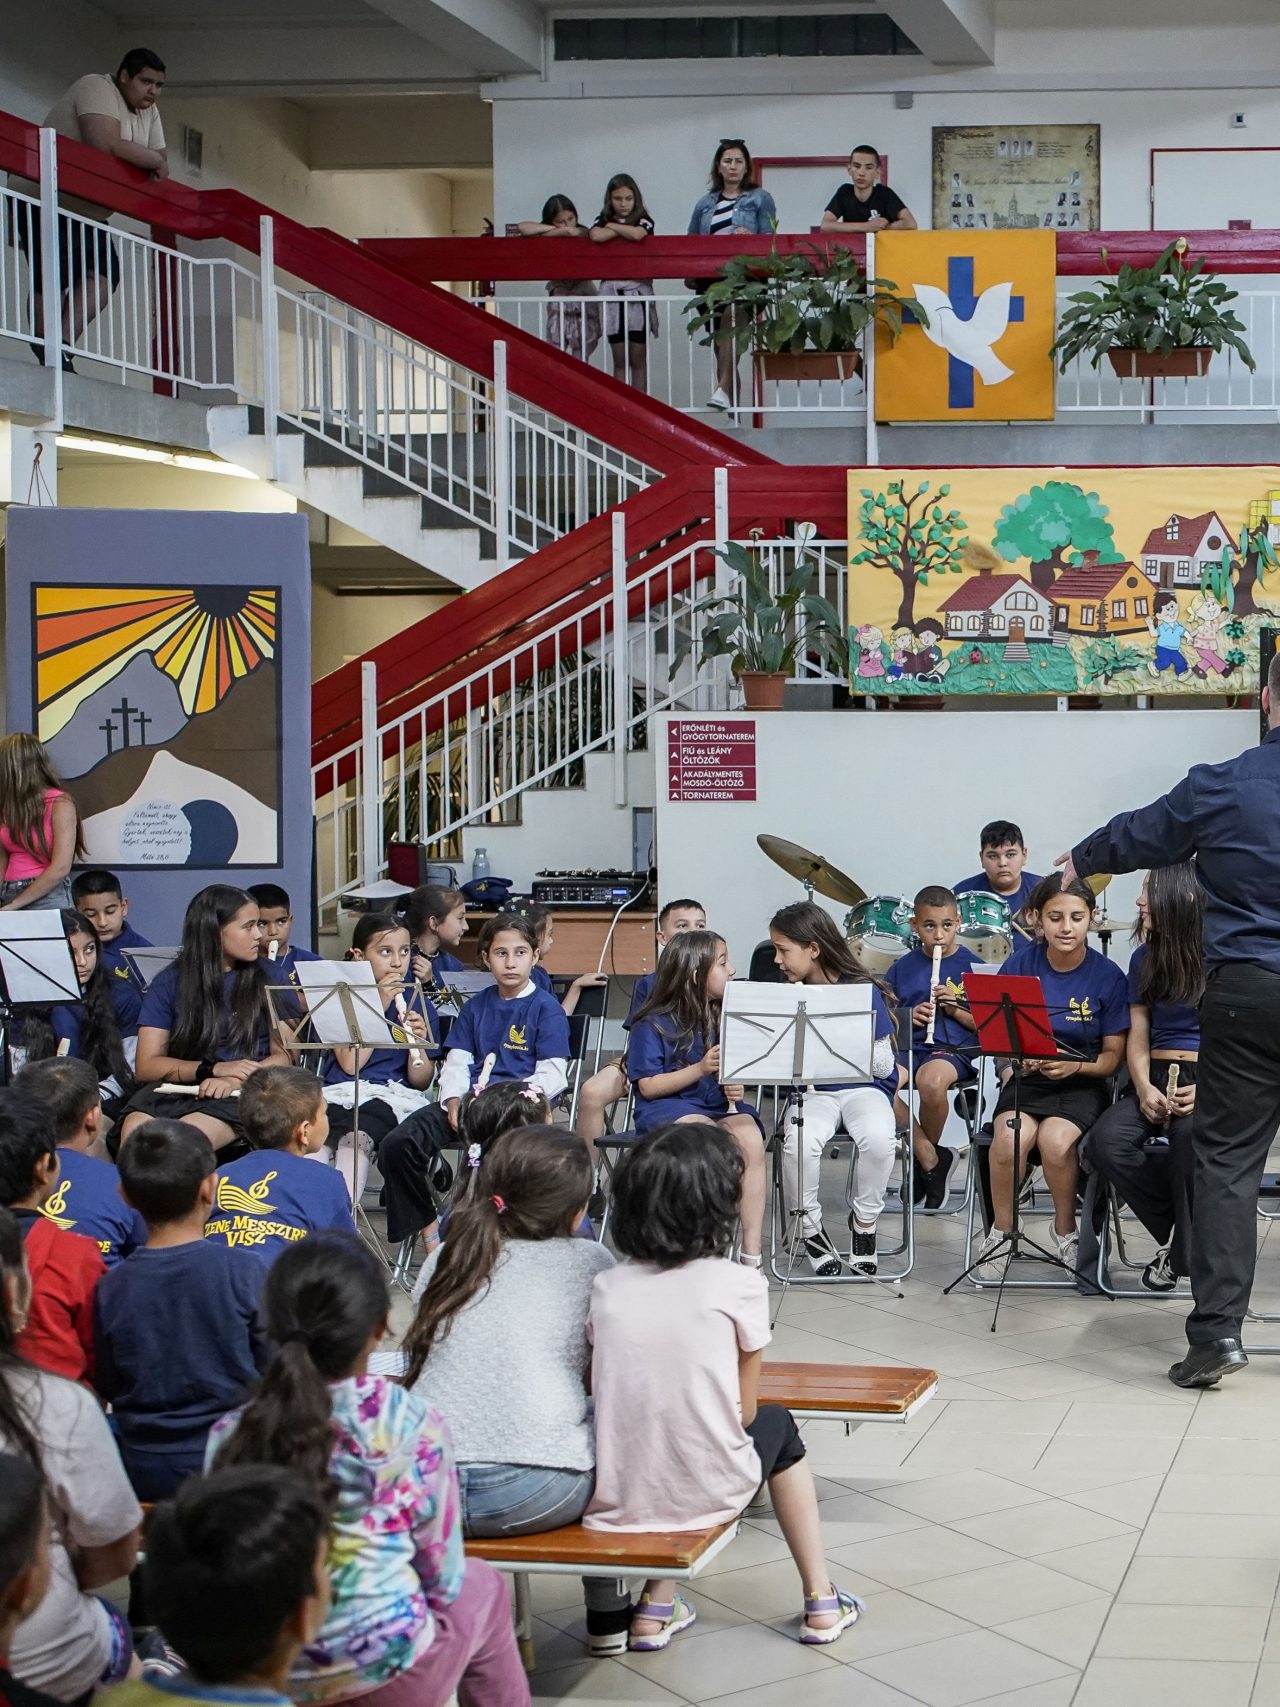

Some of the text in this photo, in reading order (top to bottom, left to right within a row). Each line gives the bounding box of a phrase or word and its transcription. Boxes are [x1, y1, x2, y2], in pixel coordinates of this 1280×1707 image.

[682, 732, 755, 741] GYÓGYTORNATEREM
[682, 746, 695, 755] FIÚ
[706, 746, 732, 755] LEÁNY
[682, 770, 744, 778] AKADÁLYMENTES
[683, 791, 734, 800] TORNATEREM
[205, 1219, 231, 1238] ZENE
[225, 1231, 267, 1248] VISZ
